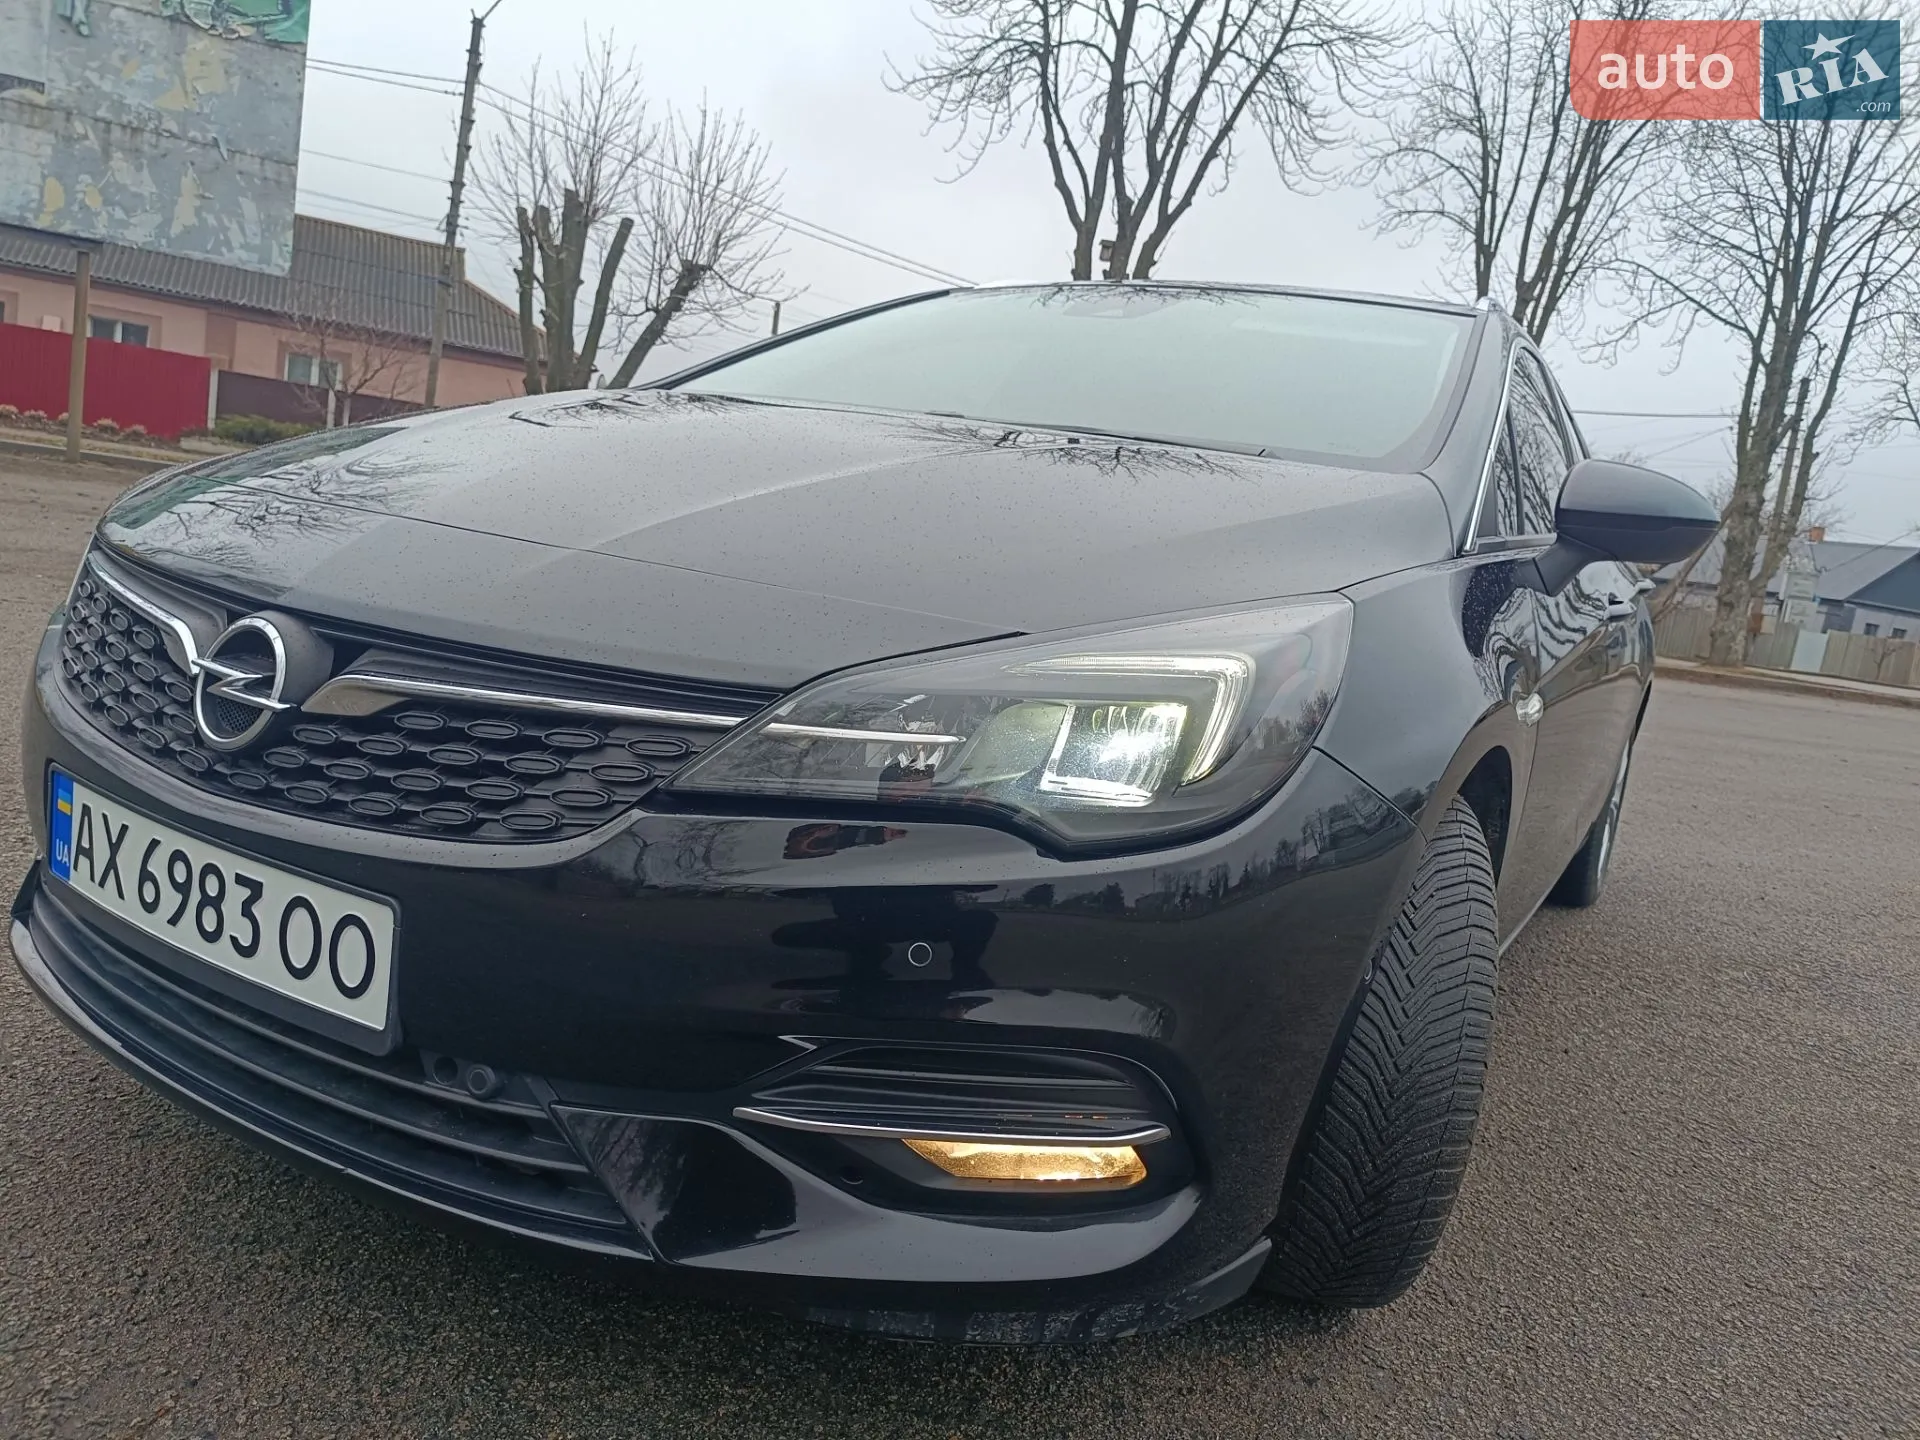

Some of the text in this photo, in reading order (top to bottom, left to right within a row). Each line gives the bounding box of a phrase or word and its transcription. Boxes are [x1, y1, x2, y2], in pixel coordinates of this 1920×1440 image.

[55, 838, 70, 867] UA
[73, 803, 129, 901] AX
[138, 838, 264, 958] 6983
